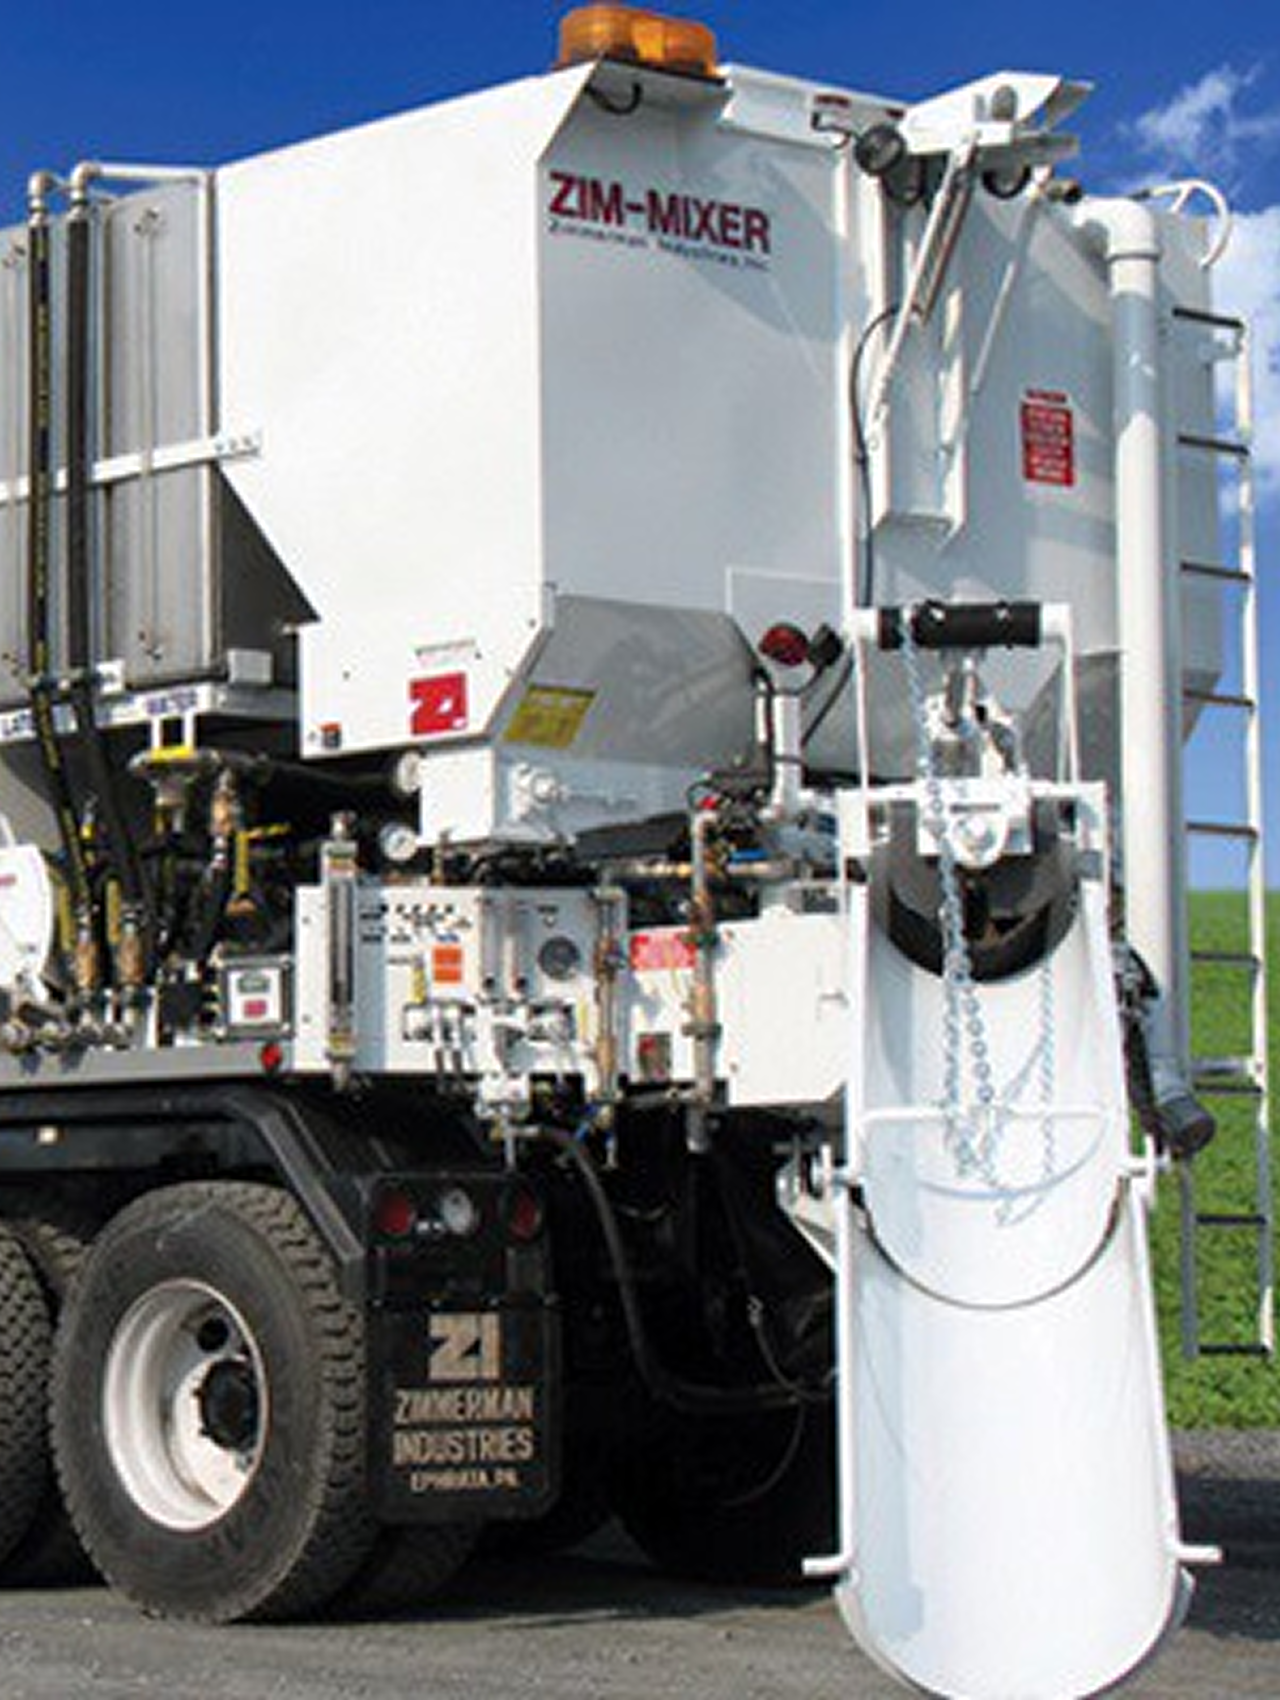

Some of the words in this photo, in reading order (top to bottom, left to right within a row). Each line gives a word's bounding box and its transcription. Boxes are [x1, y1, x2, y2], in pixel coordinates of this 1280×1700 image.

[549, 171, 771, 255] ZIM-MIXER
[394, 1386, 534, 1424] ZIMMERMAN
[393, 1426, 534, 1465] INDUSTRIES
